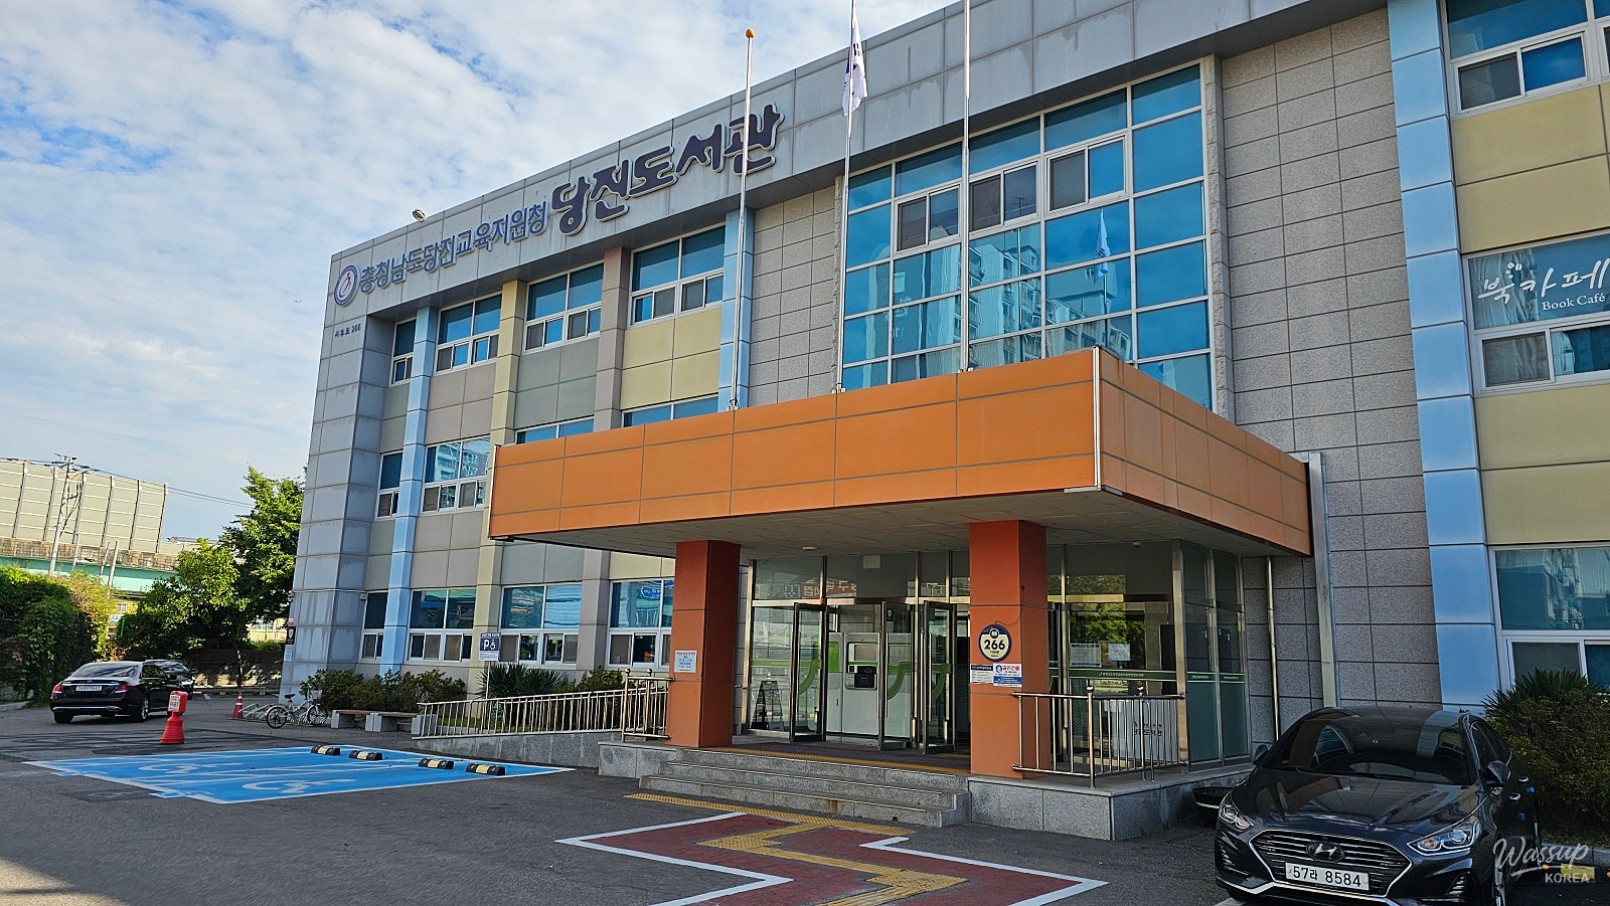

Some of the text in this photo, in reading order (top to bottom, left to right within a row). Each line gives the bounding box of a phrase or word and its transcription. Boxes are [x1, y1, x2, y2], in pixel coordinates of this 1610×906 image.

[359, 103, 785, 294] 충청남도당진교육지원청 당진도서관
[1542, 292, 1606, 311] Book Café
[984, 639, 1005, 650] 266
[1293, 865, 1361, 887] 57라 8584
